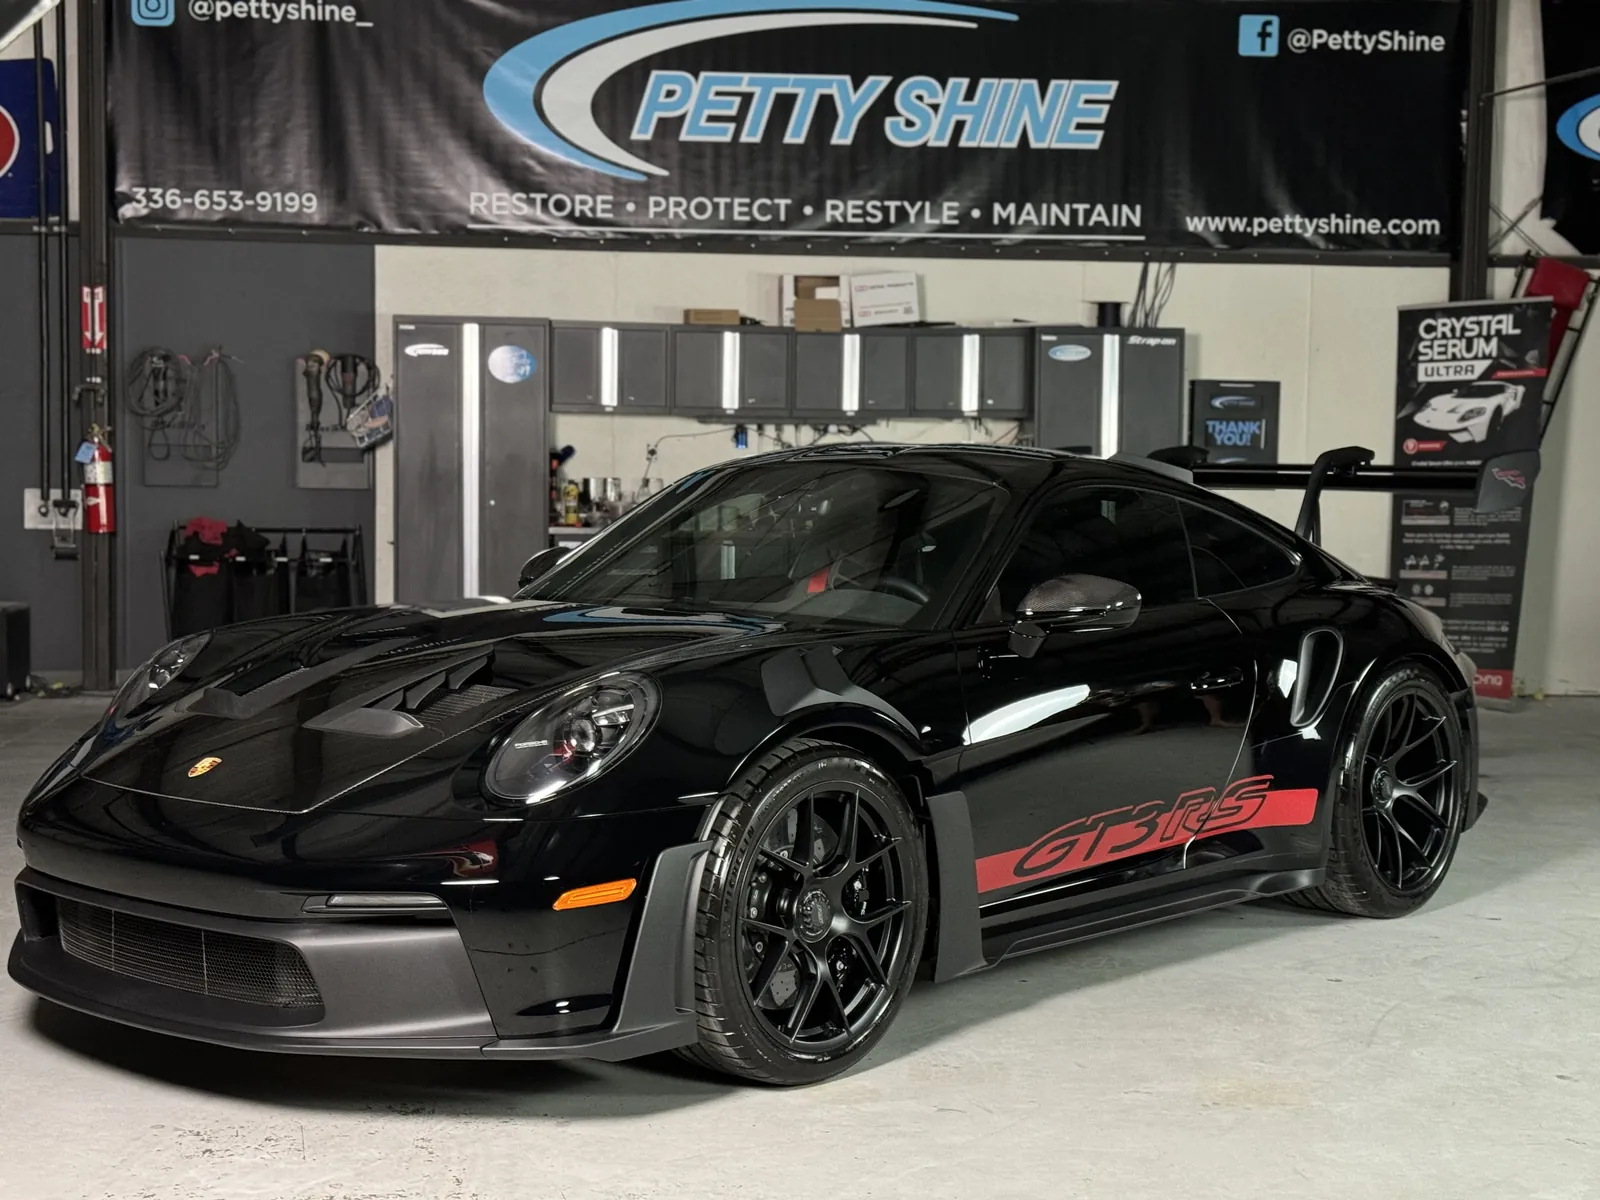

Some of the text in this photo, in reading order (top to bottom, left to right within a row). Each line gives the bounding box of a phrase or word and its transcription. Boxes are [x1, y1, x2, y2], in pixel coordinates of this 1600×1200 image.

[188, 0, 374, 27] @pettyshine_
[1287, 28, 1445, 54] @PettyShine
[630, 70, 1119, 149] PETTY SHINE
[131, 187, 318, 214] 336-653-9199
[469, 191, 1142, 228] RESTORE PROTECT RESTYLE MAINTAIN
[1185, 213, 1441, 238] www.pettyshine.com
[1418, 313, 1522, 340] CRYSTAL
[1417, 336, 1498, 361] SERUM
[1424, 364, 1475, 377] ULTRA
[1205, 420, 1260, 435] THANK
[1214, 433, 1252, 447] YOU!
